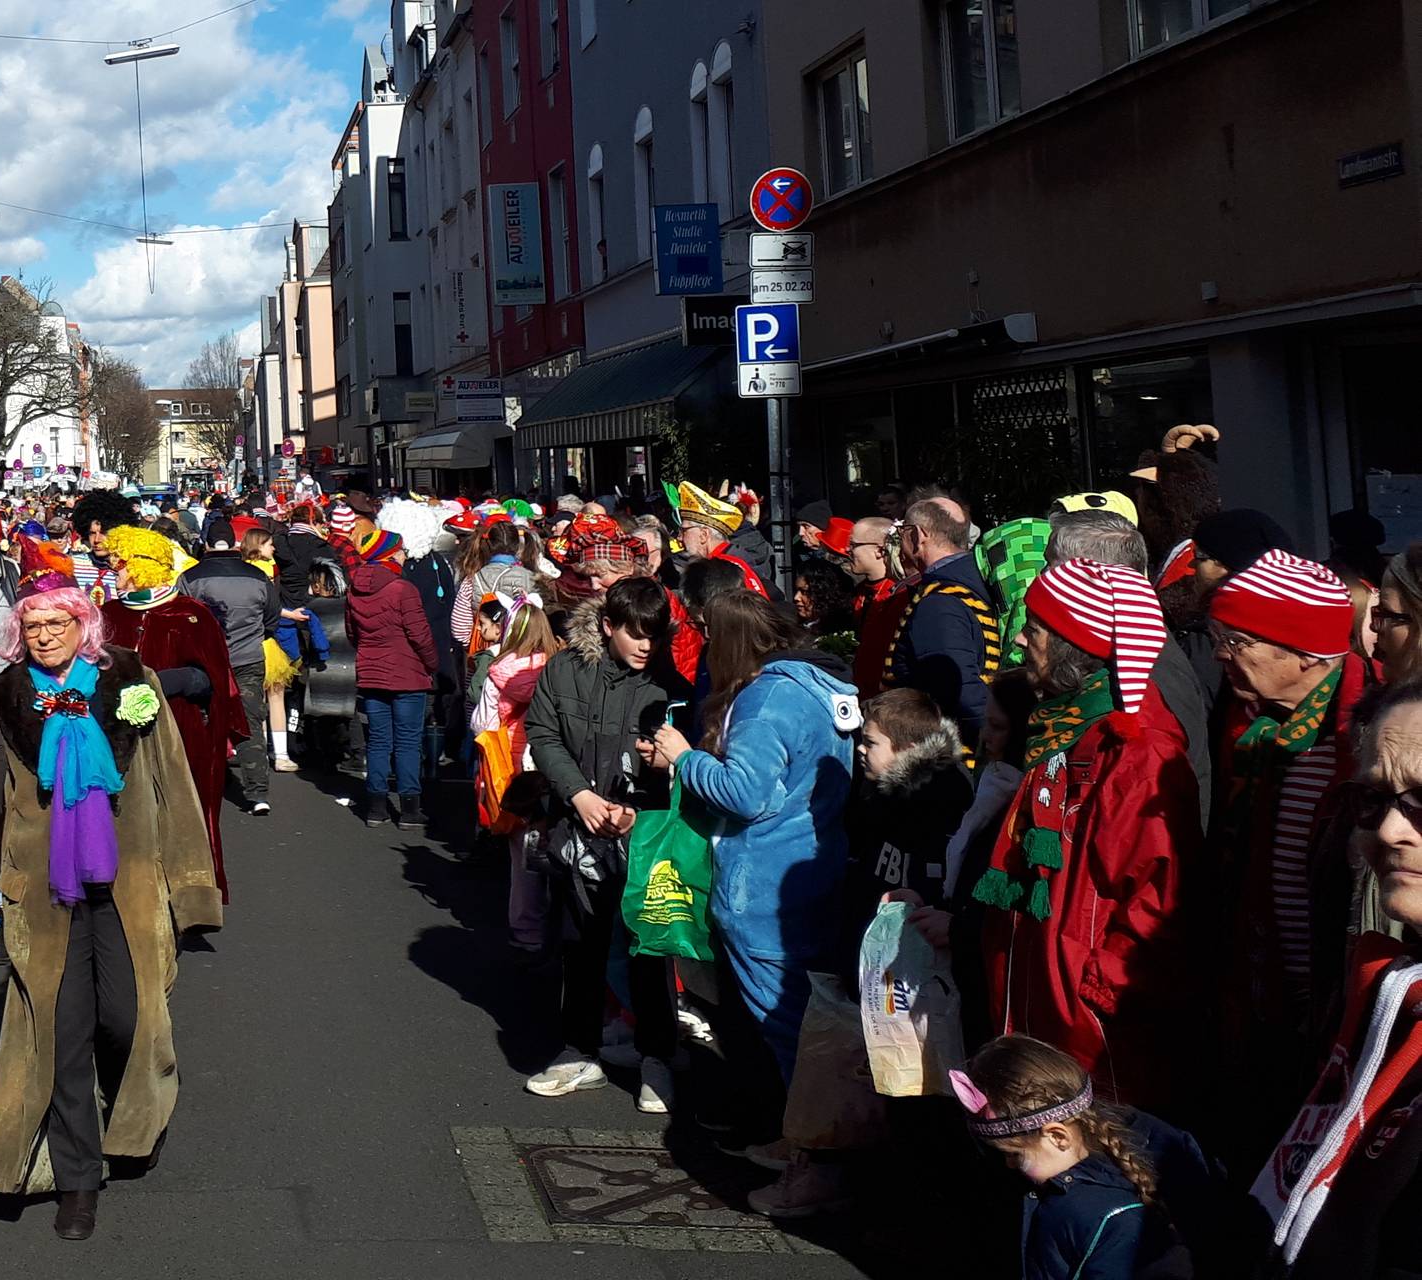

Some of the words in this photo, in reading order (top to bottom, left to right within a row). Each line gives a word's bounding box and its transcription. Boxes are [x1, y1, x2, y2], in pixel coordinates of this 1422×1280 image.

[753, 284, 769, 294] am
[770, 281, 812, 293] 25.02.20
[746, 313, 780, 360] P
[874, 841, 911, 887] FBI
